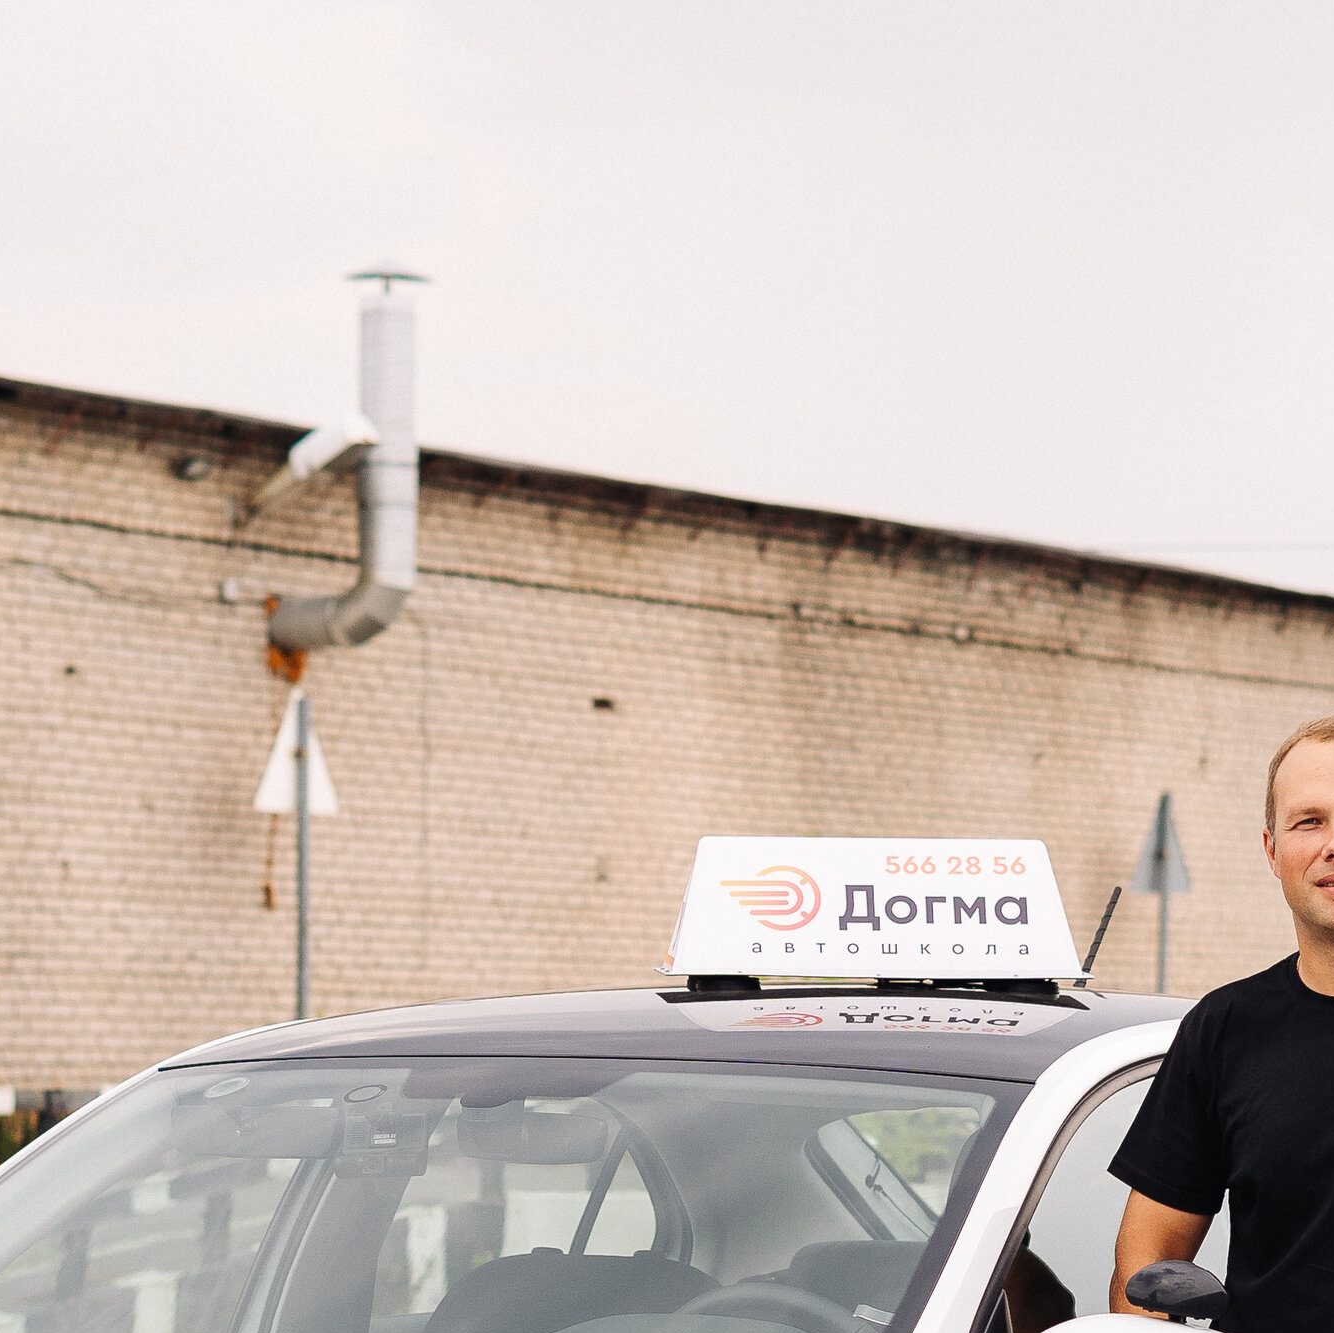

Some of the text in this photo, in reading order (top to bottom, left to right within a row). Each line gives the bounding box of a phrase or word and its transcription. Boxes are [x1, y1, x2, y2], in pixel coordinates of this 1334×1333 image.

[884, 856, 1027, 876] 566 28 56
[838, 884, 1029, 932] Догма
[751, 942, 1030, 956] автошкола
